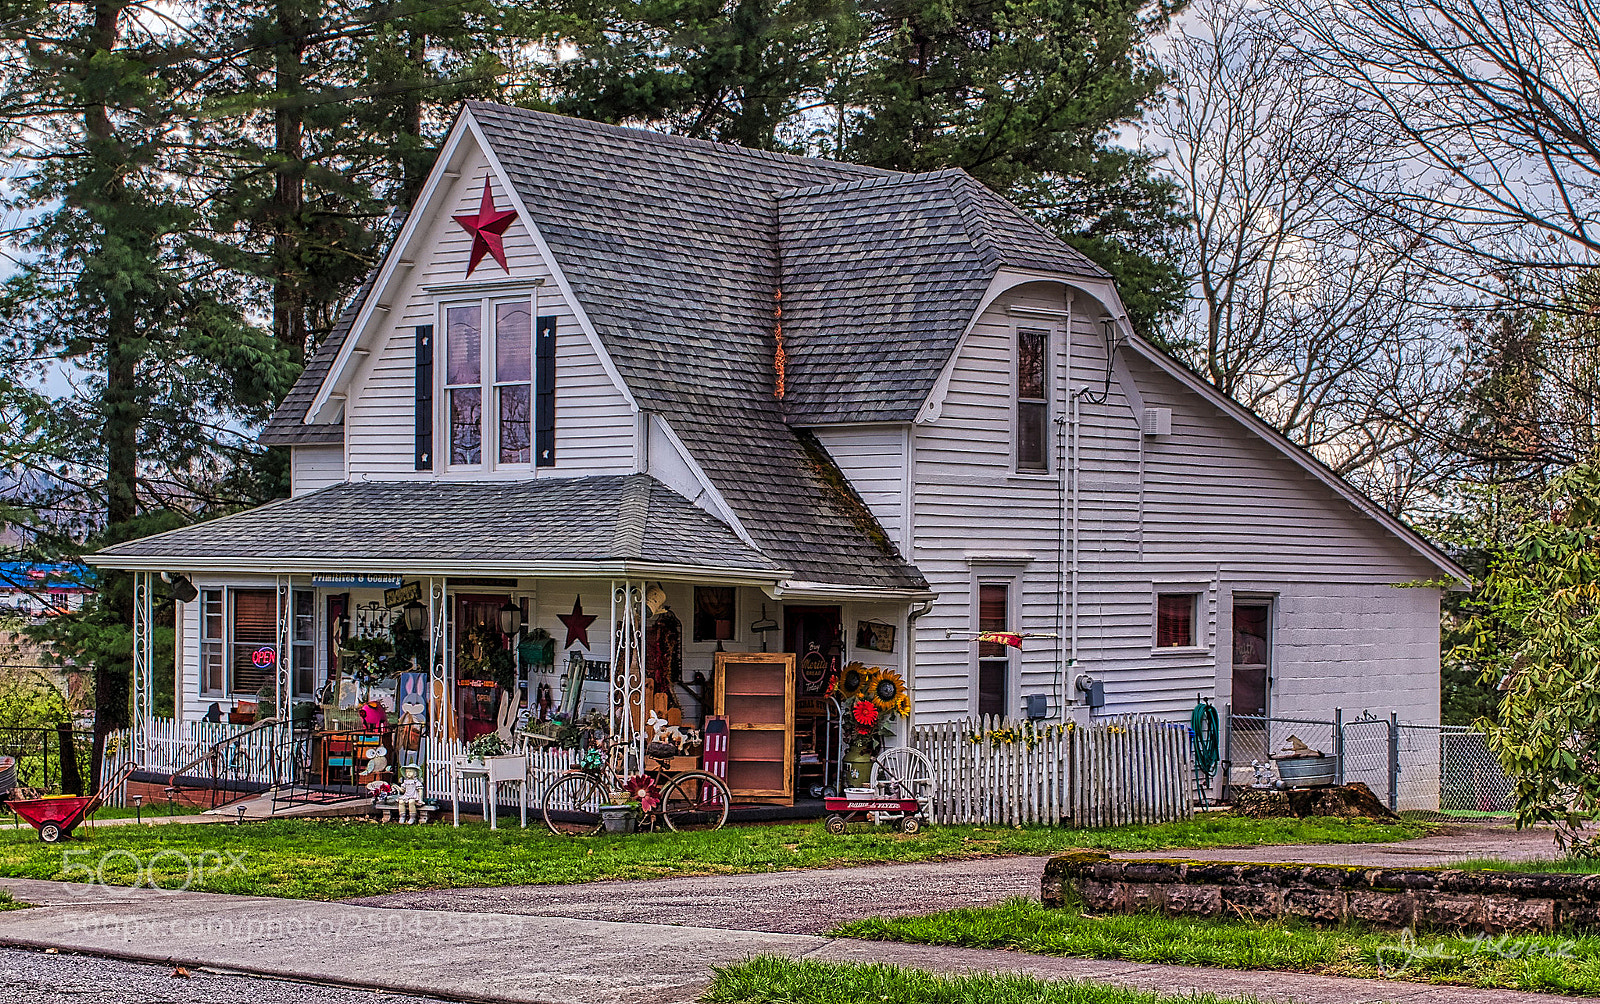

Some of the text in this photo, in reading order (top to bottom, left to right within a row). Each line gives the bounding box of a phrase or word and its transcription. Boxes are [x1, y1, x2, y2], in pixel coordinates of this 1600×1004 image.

[357, 573, 365, 582] &
[252, 650, 276, 664] OPEN
[476, 693, 492, 702] OPEN
